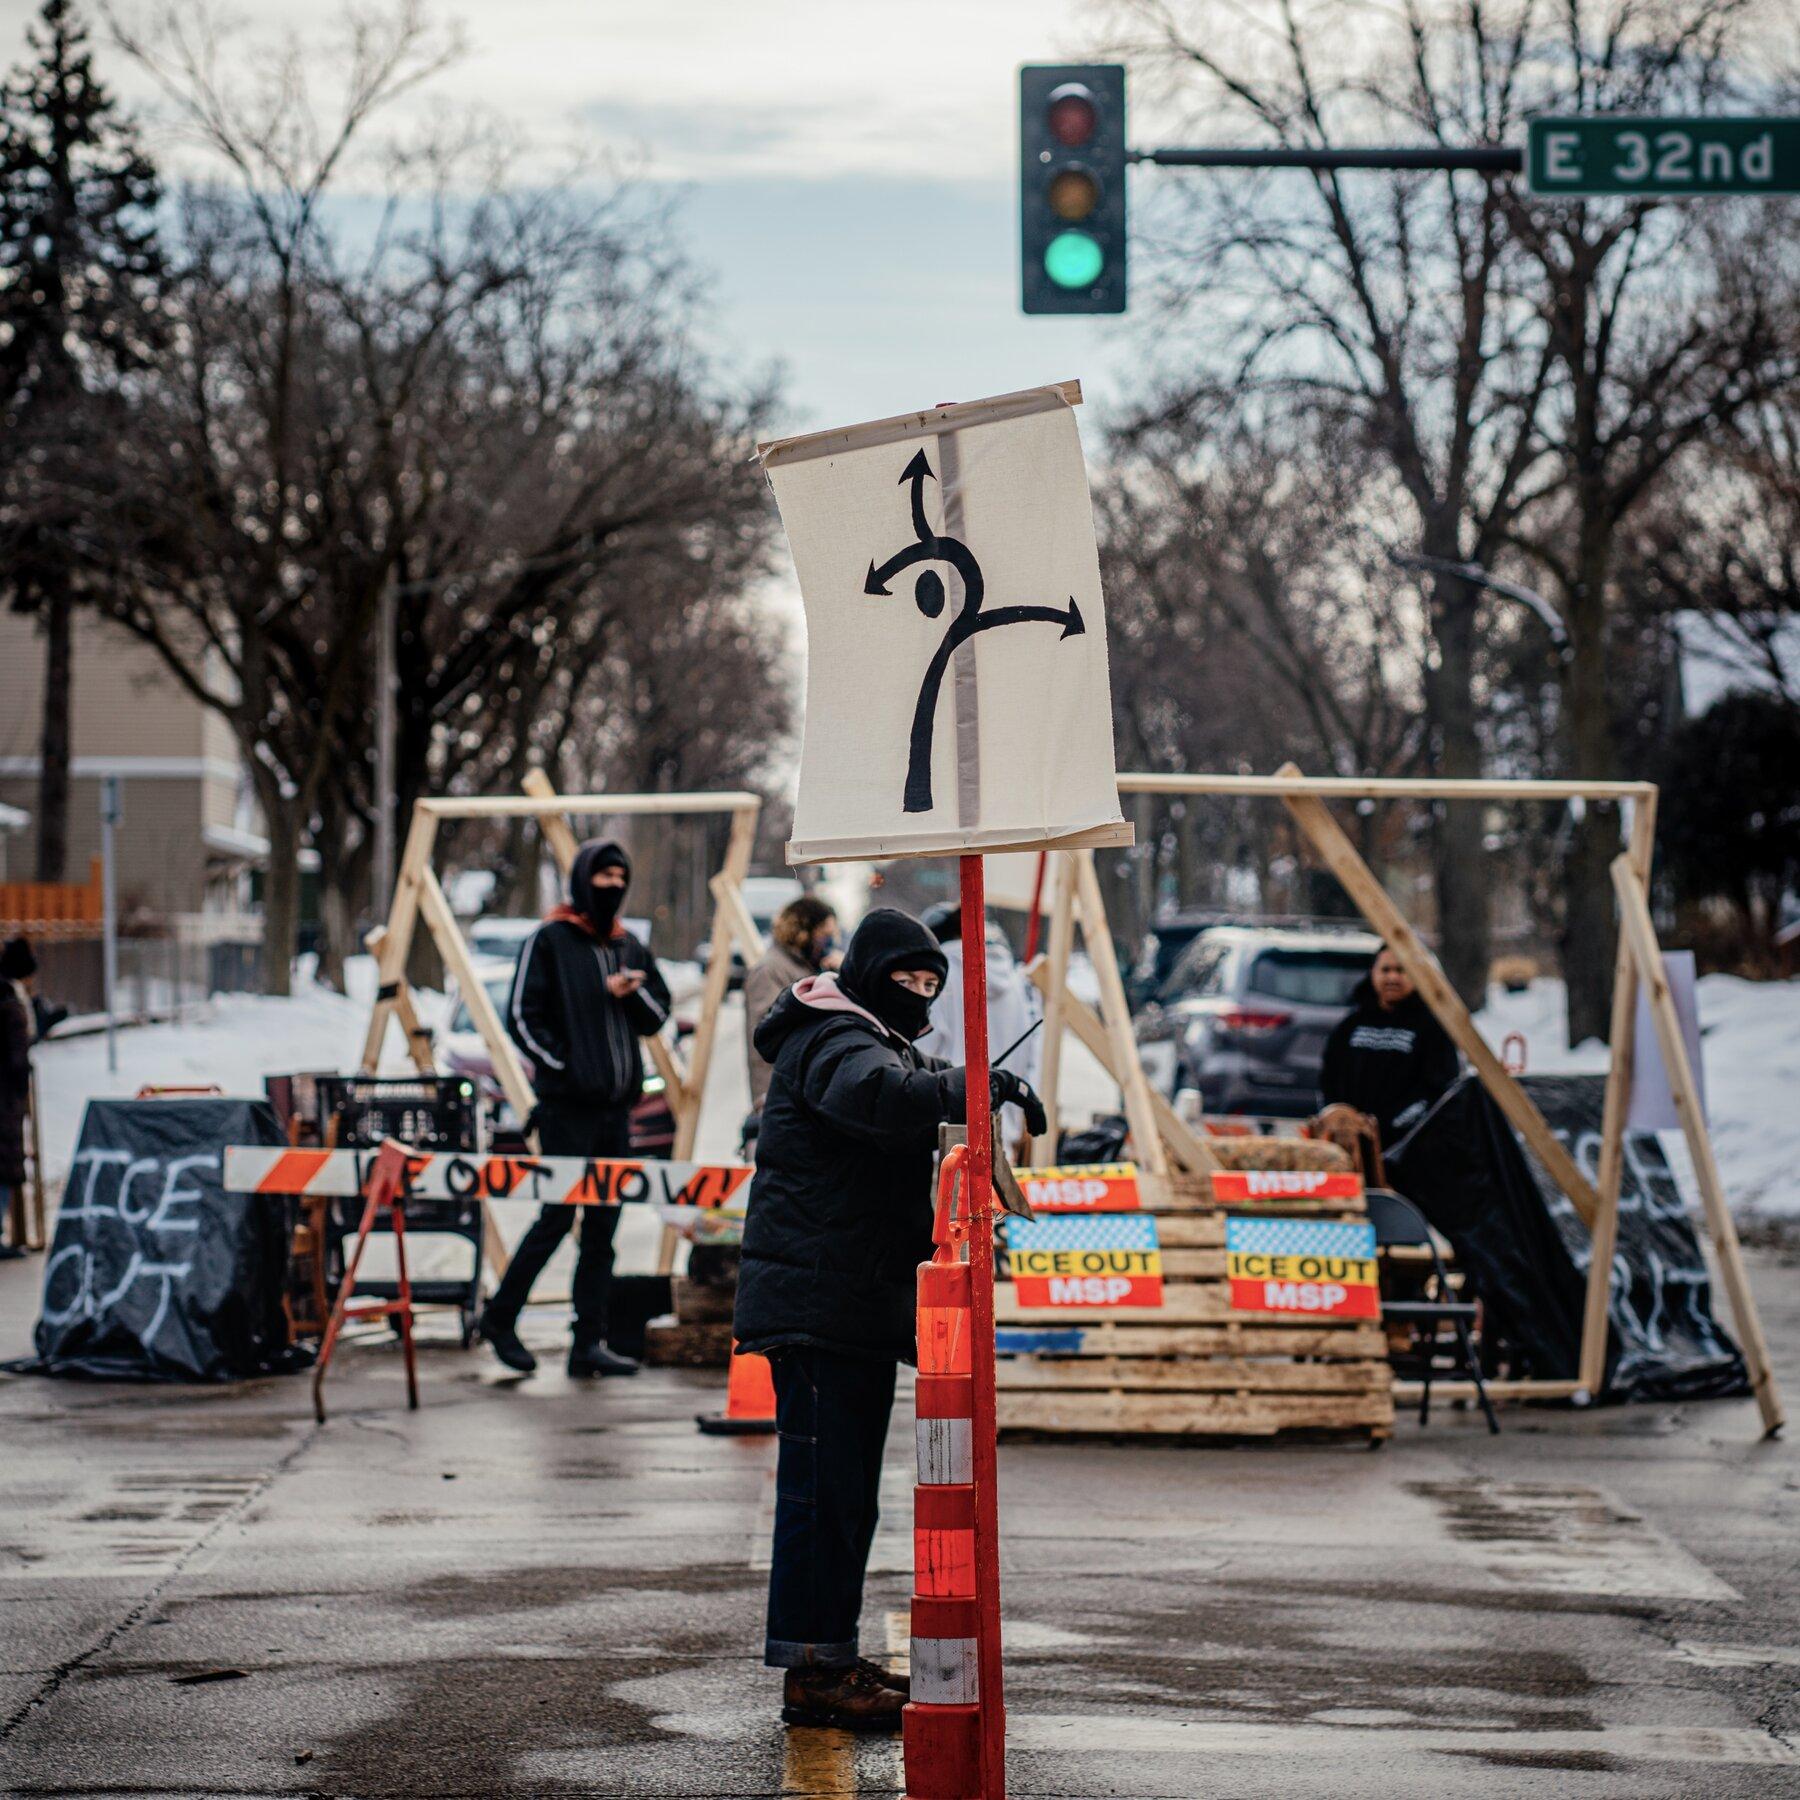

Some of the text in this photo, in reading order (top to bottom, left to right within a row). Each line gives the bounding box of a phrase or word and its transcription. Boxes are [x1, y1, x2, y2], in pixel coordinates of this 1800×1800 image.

[1546, 131, 1774, 182] E 32nd
[58, 1148, 219, 1232] ICE
[446, 1154, 553, 1200] OUT
[583, 1157, 731, 1209] NOW!
[1026, 1178, 1109, 1205] MSP
[1016, 1252, 1152, 1274] ICE OUT
[1233, 1255, 1370, 1281] ICE OUT
[43, 1244, 192, 1347] OUT
[1048, 1276, 1133, 1304] MSP
[1263, 1281, 1348, 1311] MSP
